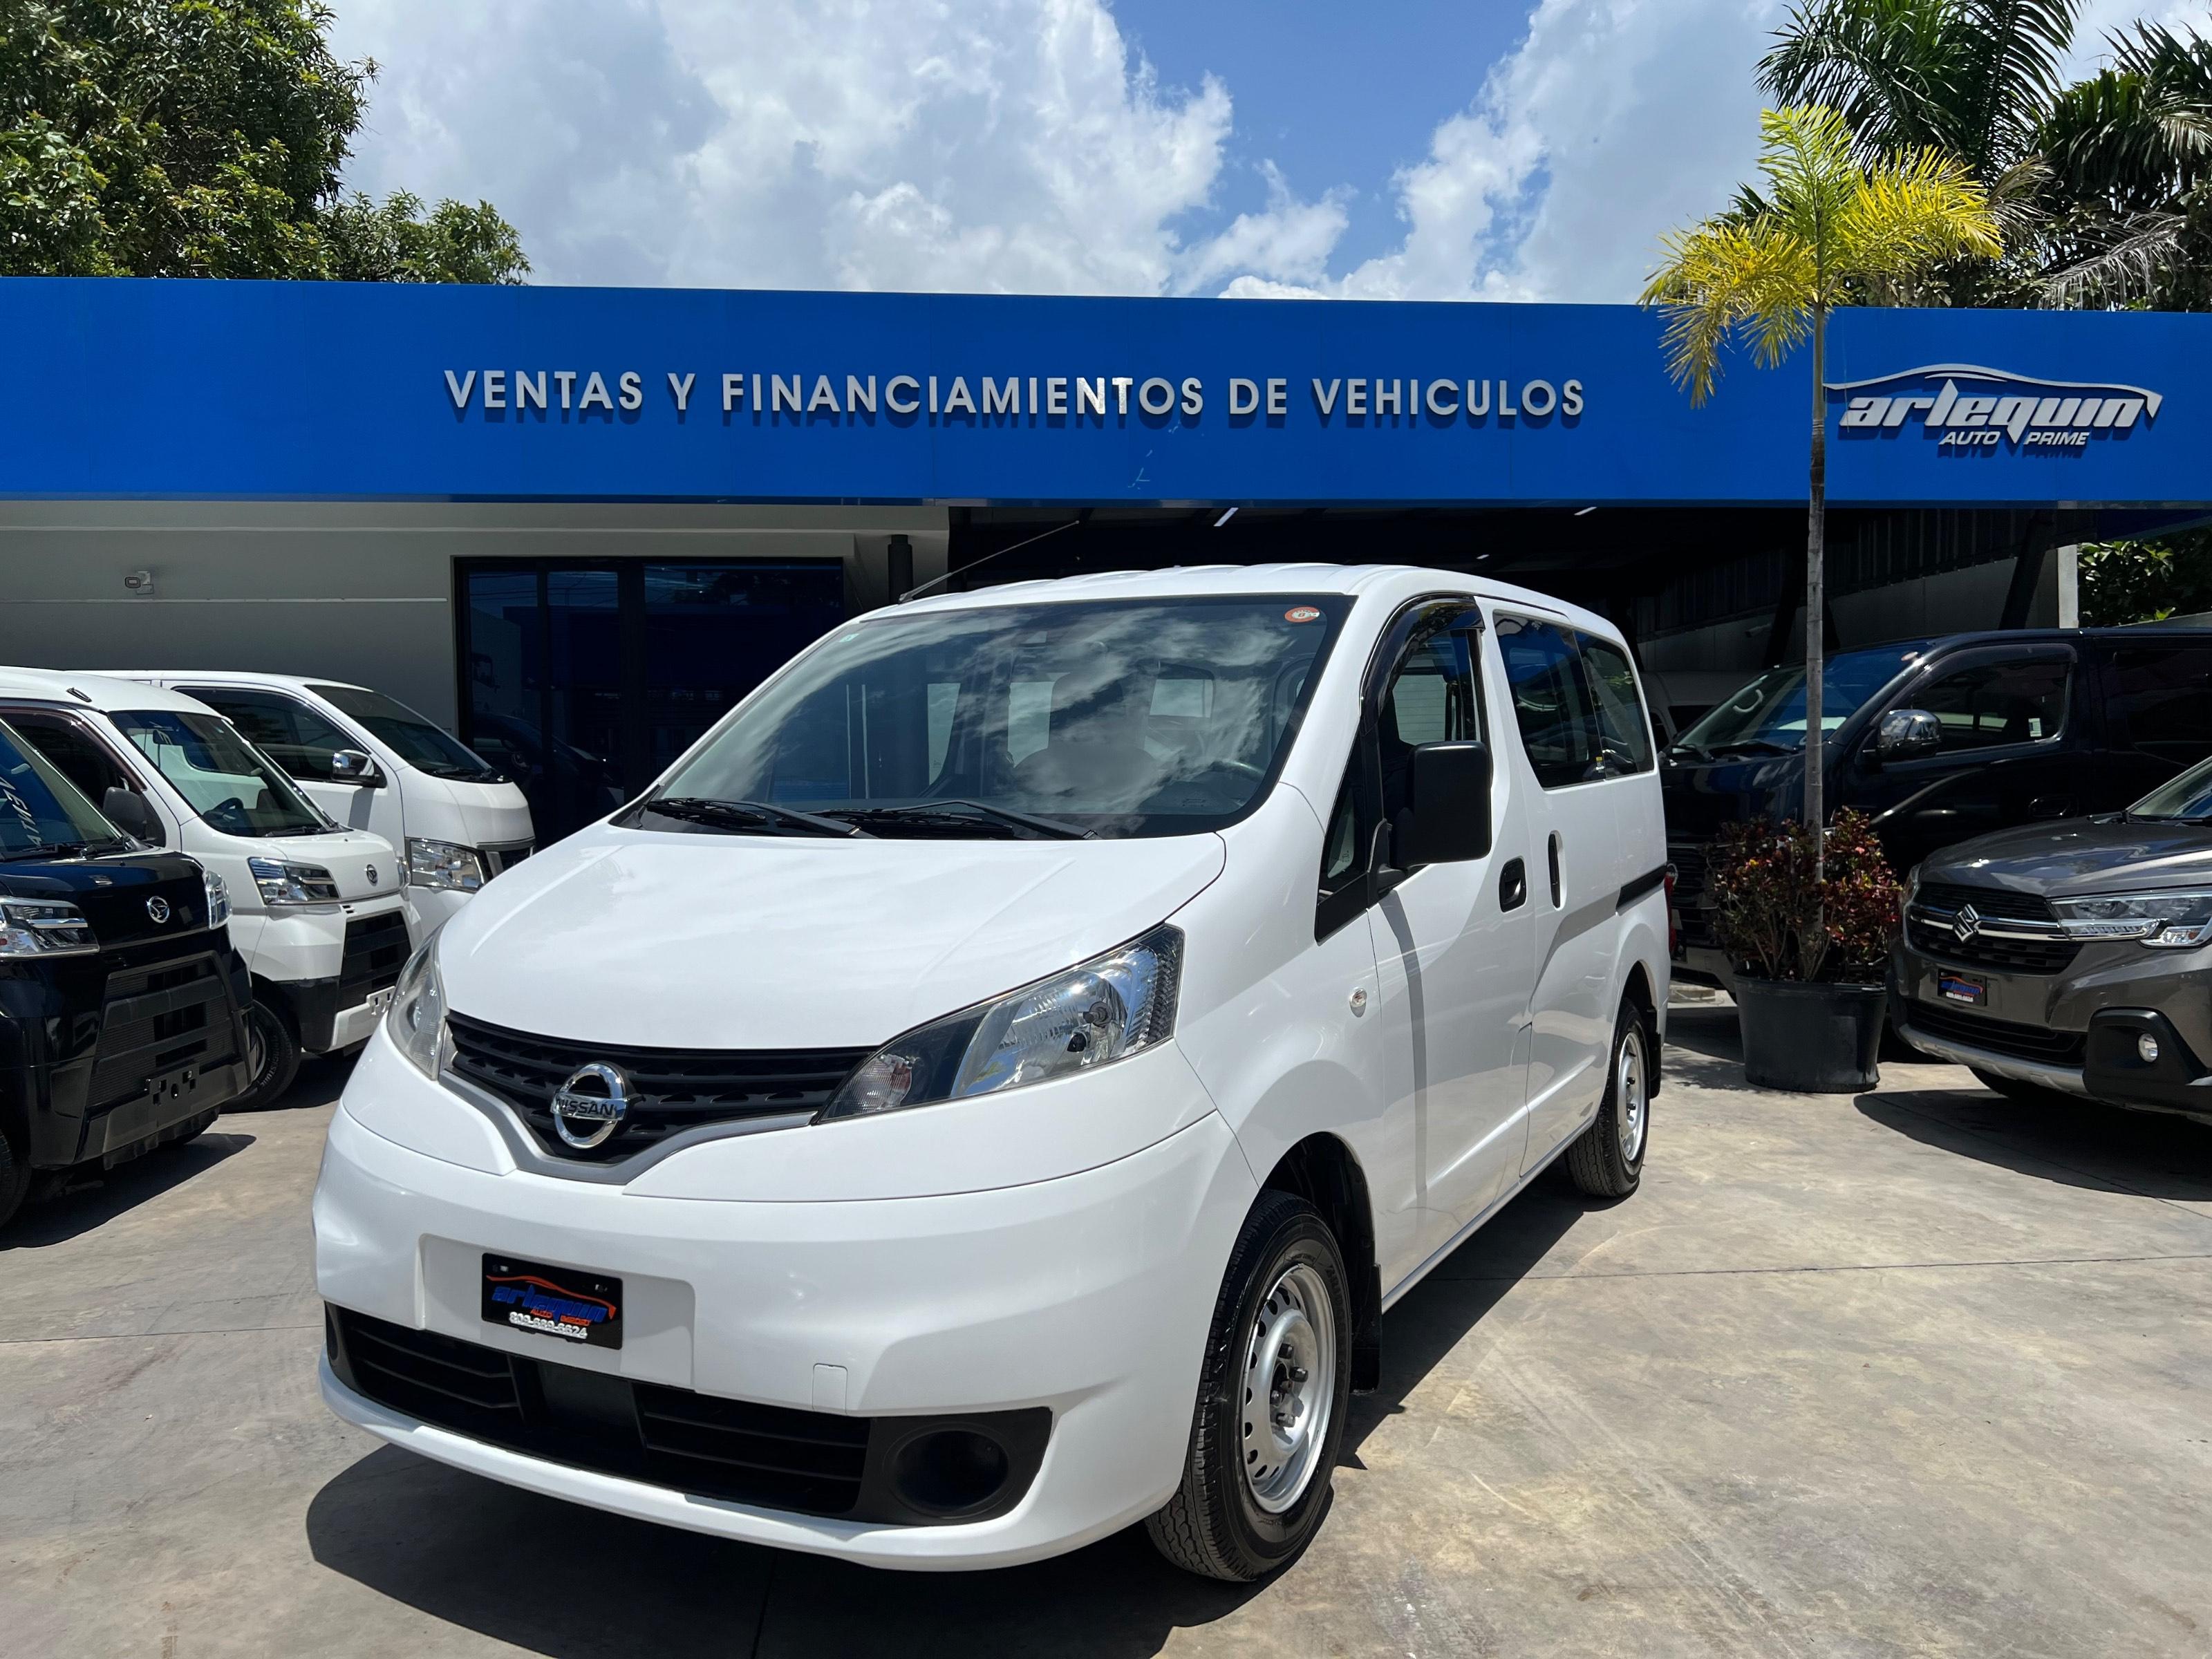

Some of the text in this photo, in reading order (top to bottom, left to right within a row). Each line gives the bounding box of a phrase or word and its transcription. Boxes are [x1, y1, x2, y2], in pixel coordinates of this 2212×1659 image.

[444, 370, 1584, 416] VENTAS Y FINANCIAMIENTOS DE VEHICULOS
[1840, 379, 2145, 444] arlequin
[1938, 431, 2090, 445] AUTO PRIME
[556, 1098, 615, 1116] NISSAN
[530, 1309, 554, 1319] AUTO
